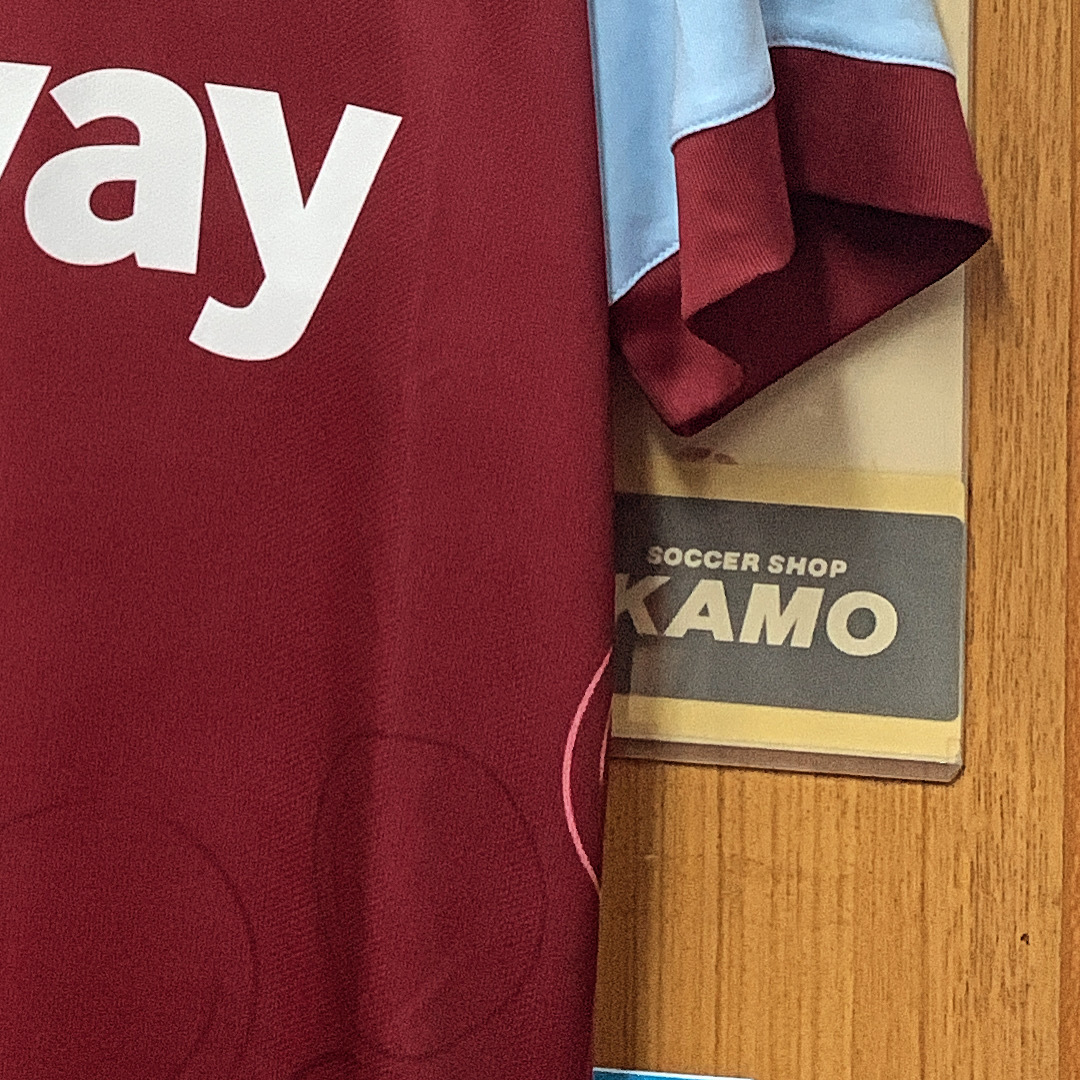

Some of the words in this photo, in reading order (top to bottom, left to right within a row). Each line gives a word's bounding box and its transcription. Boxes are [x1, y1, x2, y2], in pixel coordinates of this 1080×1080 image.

[647, 546, 760, 572] SOCCER
[767, 554, 848, 578] SHOP
[614, 572, 898, 657] KAMO
